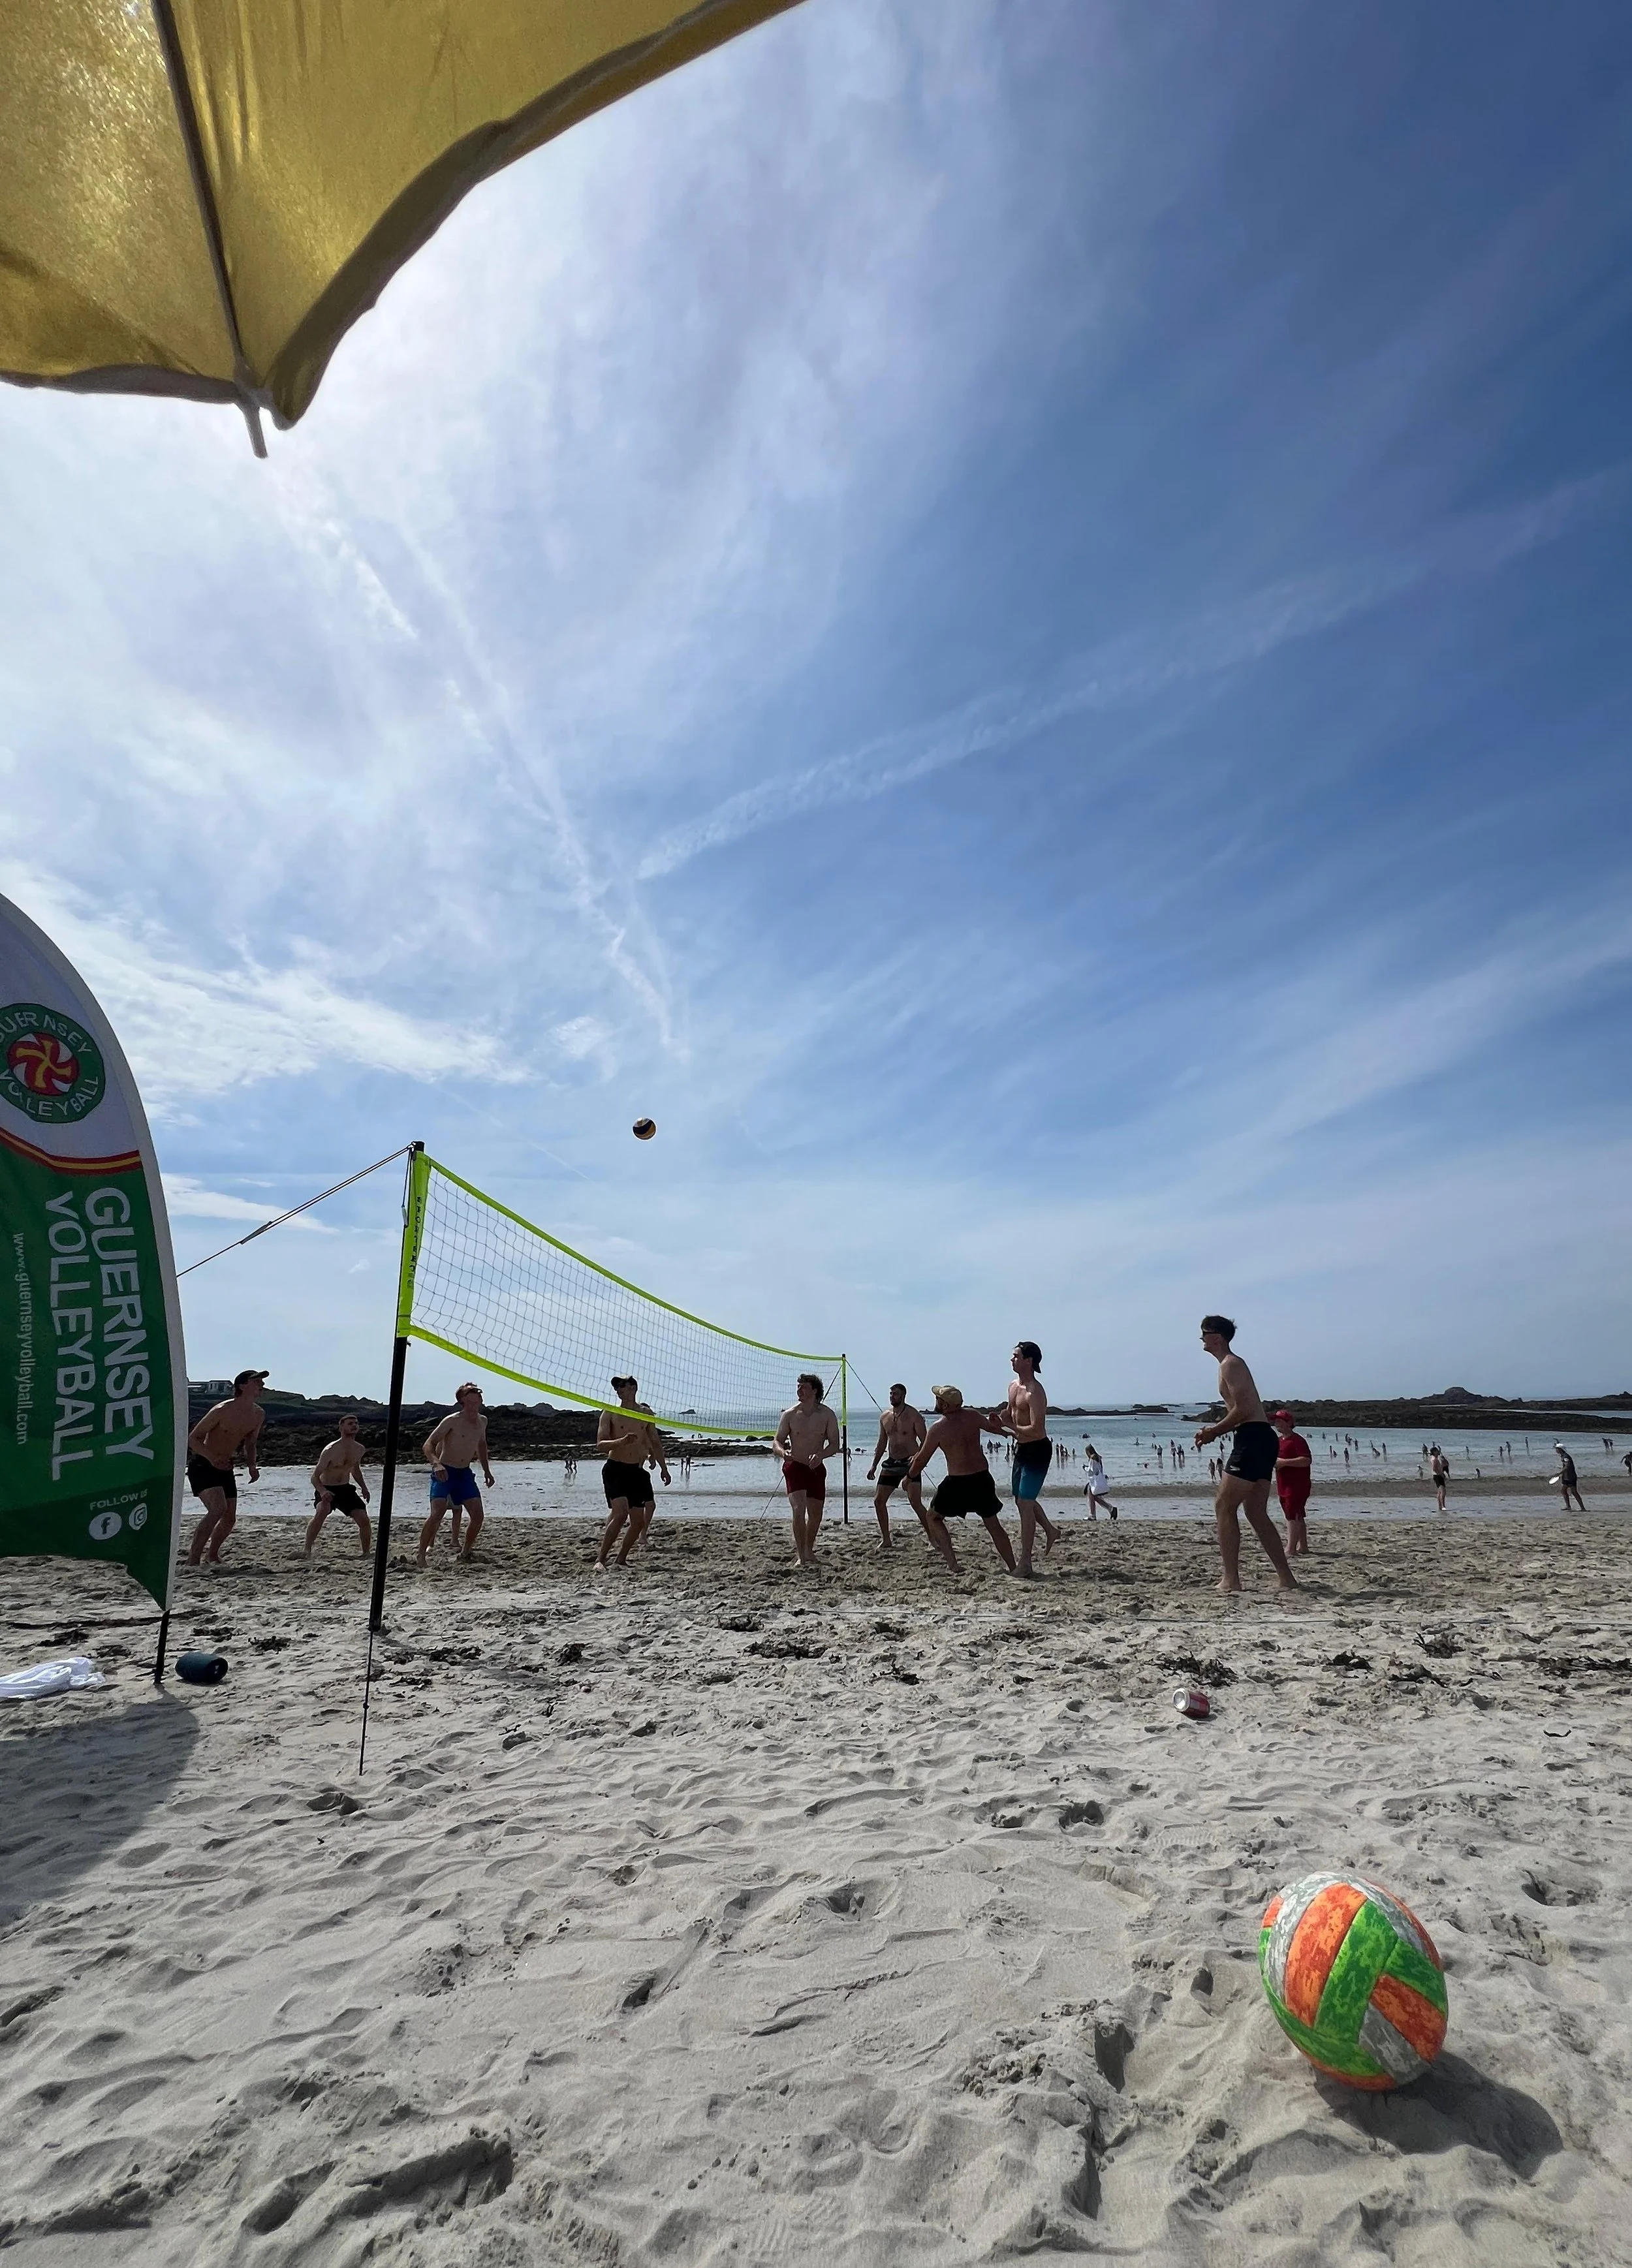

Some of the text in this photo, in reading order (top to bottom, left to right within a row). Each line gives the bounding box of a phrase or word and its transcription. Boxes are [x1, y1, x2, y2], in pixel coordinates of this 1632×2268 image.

[12, 1232, 35, 1444] www.guernseyvolleyball.com
[45, 1190, 96, 1481] VOLLEYBALL
[85, 1187, 155, 1461] GUERNSEY
[89, 1493, 138, 1510] FOLLOW
